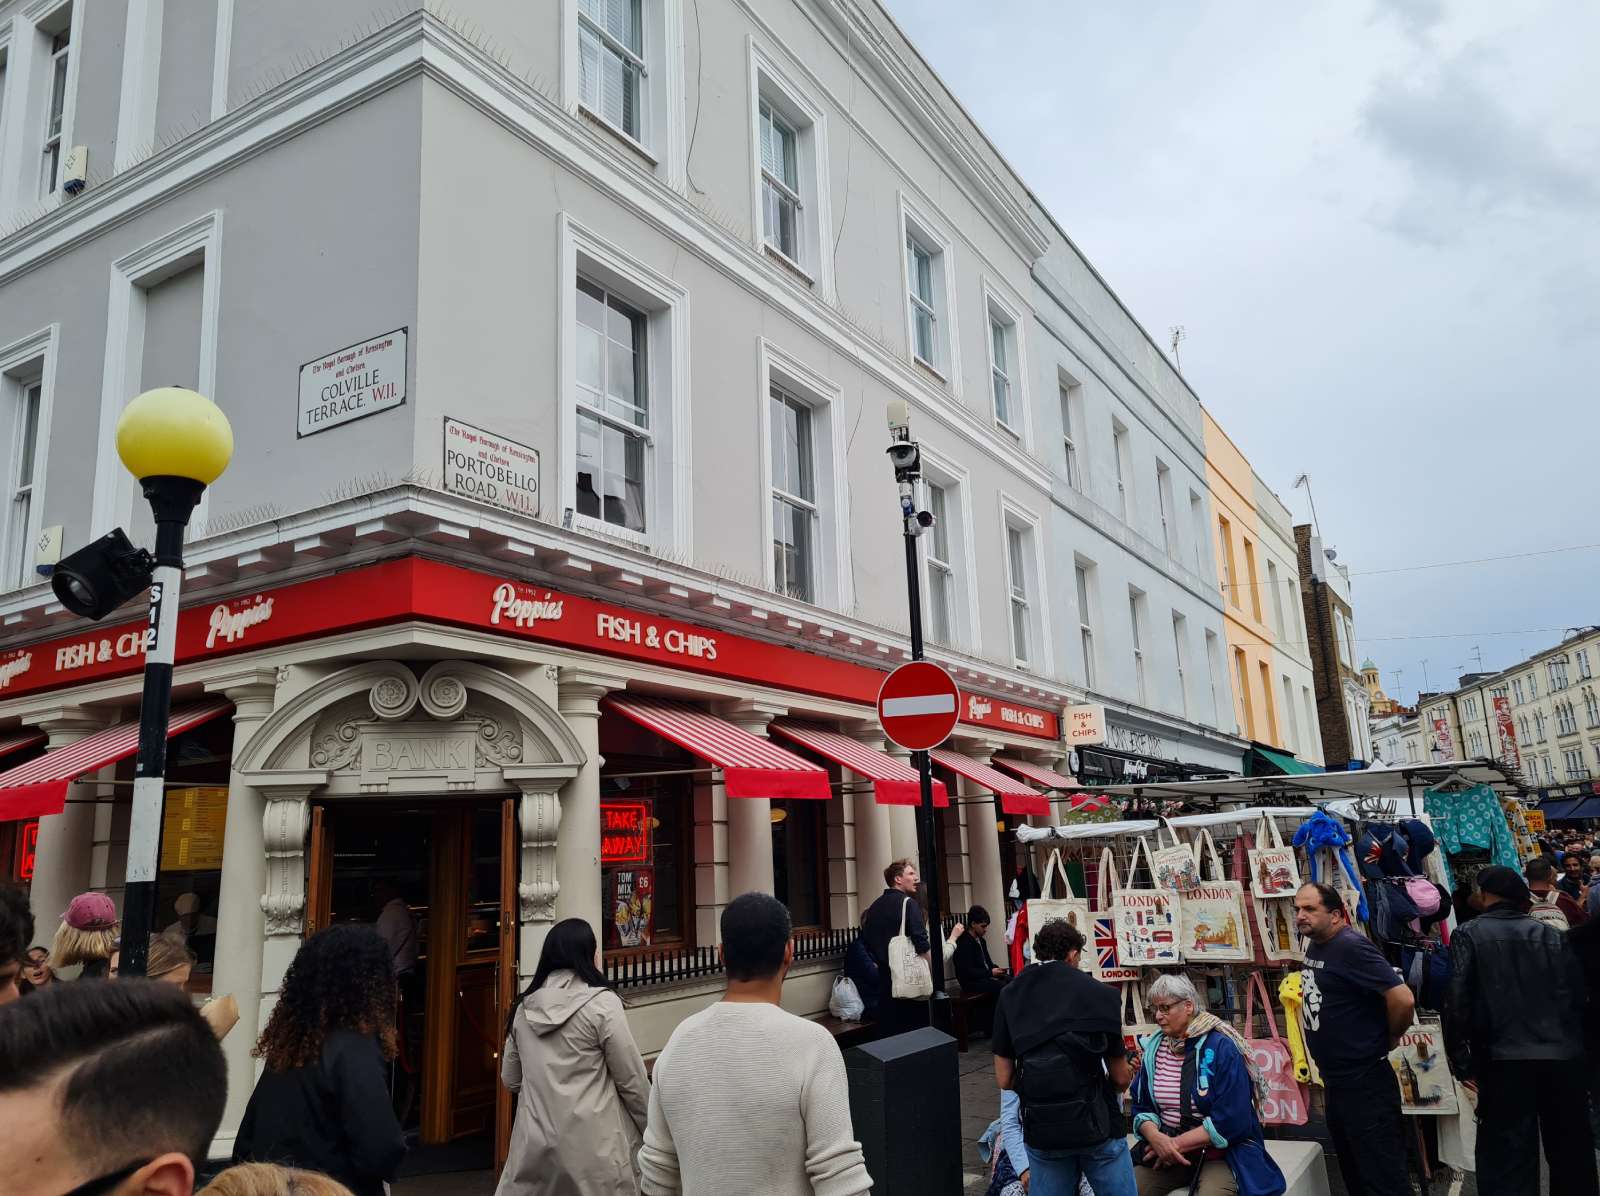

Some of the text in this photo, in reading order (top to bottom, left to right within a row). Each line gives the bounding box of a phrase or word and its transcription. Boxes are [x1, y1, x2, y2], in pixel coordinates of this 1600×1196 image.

[336, 351, 356, 364] Borough
[365, 339, 393, 355] Kensington
[321, 368, 380, 402] COLVILLE
[447, 449, 537, 493] PORTOBELLO
[490, 583, 564, 628] Poppies
[597, 613, 718, 661] FISH & CHIPS
[55, 641, 97, 672] FISH
[97, 639, 113, 662] &
[1073, 712, 1092, 720] FISH
[1072, 729, 1098, 738] CHIPS
[372, 739, 468, 770] BANK
[605, 811, 638, 833] TAKE
[1254, 853, 1292, 865] LONDON
[639, 876, 649, 889] £6
[1122, 895, 1171, 907] LONDON
[1186, 888, 1233, 901] LONDON
[1101, 969, 1139, 979] LONDON
[1400, 1032, 1434, 1048] DON
